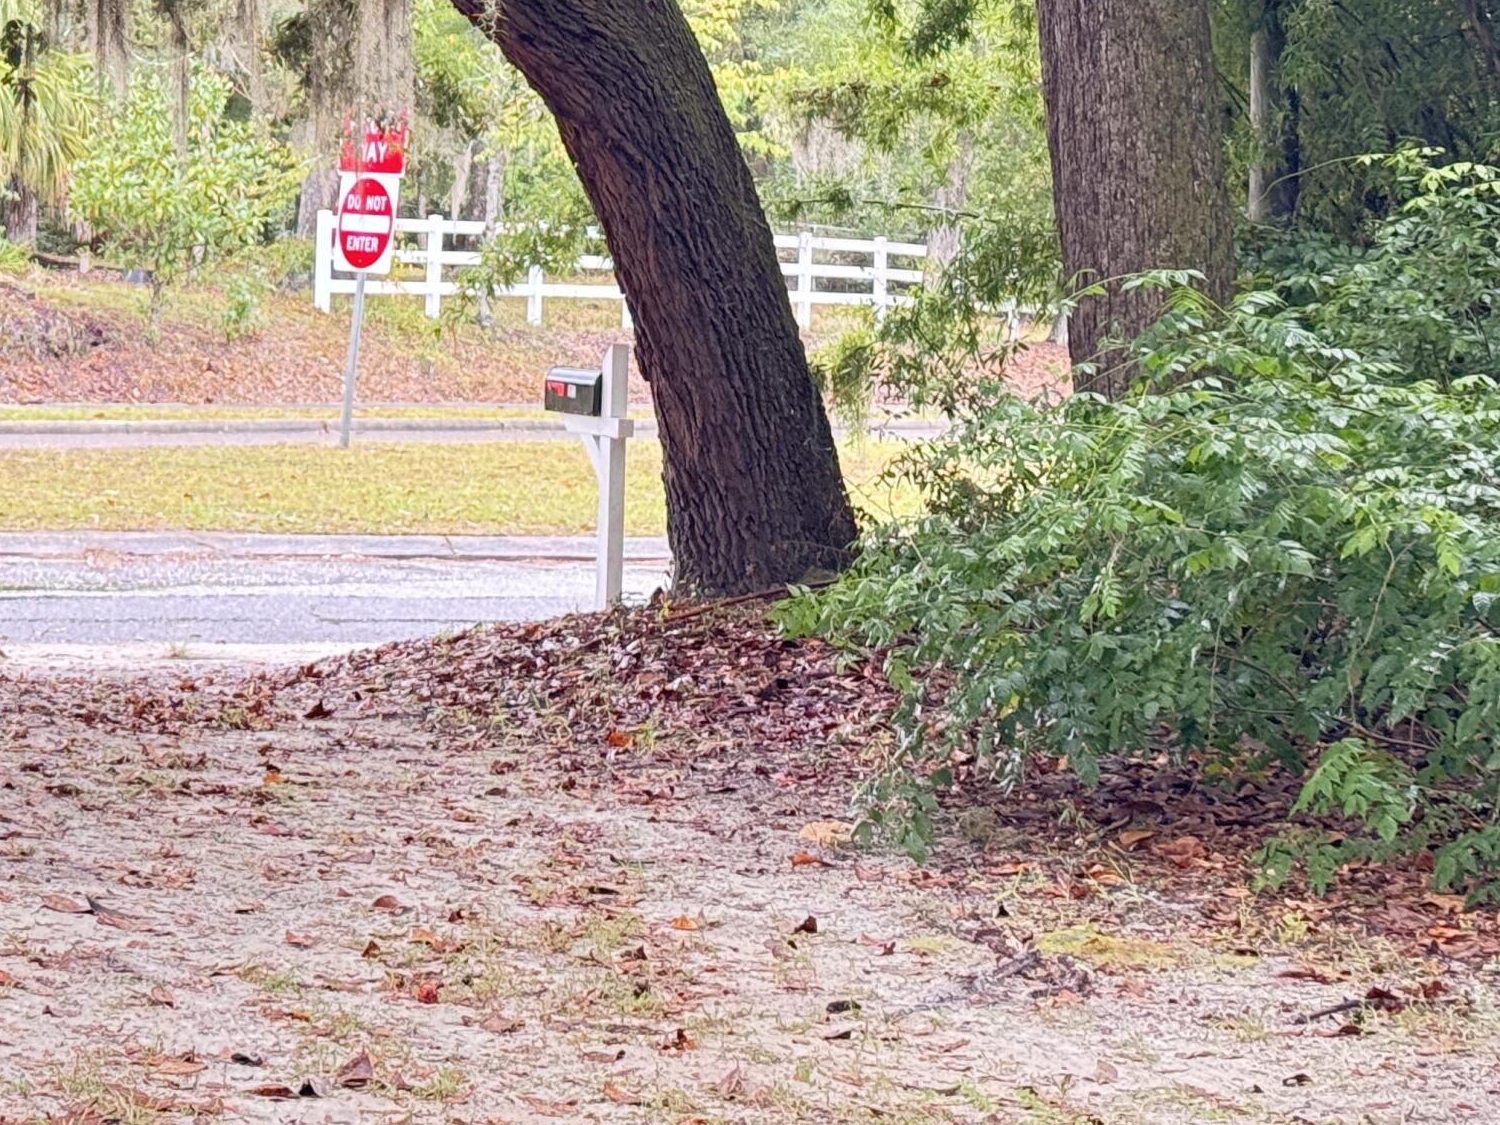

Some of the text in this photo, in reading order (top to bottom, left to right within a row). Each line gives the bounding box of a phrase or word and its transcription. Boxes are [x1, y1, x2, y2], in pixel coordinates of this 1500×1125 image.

[347, 193, 388, 212] DO NOT
[346, 235, 379, 253] ENTER
